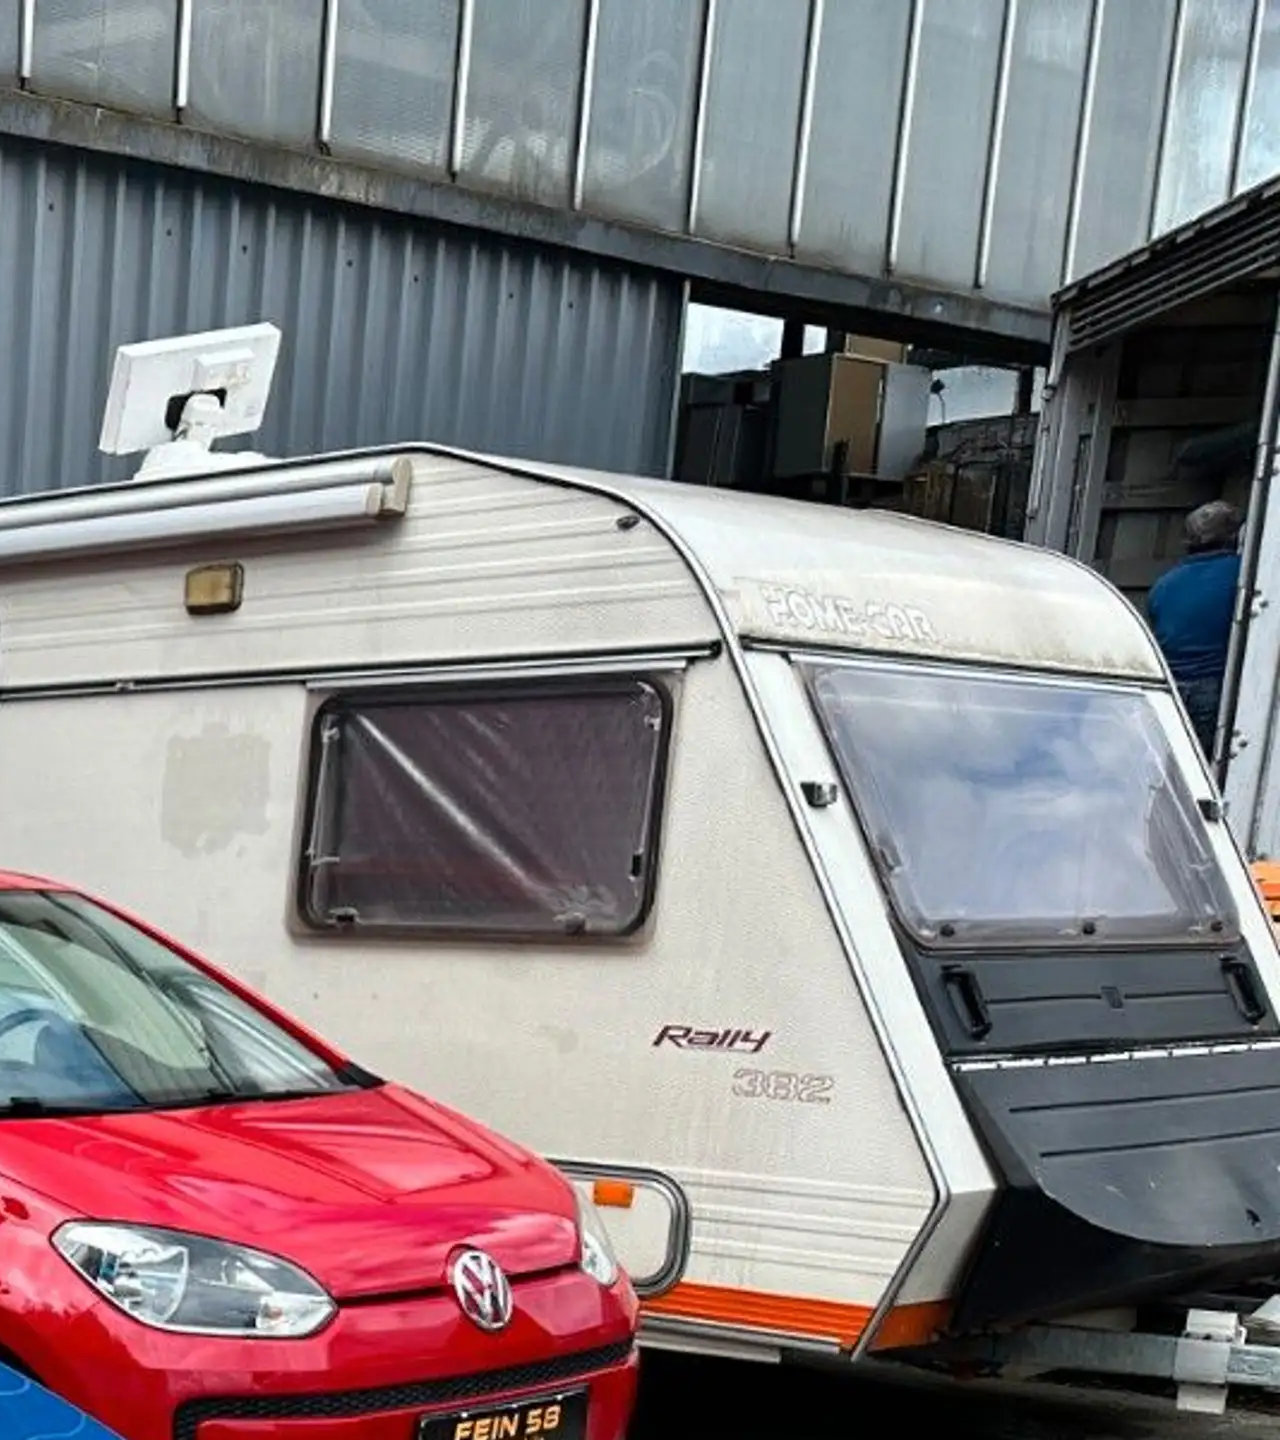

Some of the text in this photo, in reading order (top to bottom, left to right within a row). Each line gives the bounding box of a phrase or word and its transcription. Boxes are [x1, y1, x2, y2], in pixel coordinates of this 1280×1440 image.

[653, 1024, 772, 1053] Rally
[733, 1068, 834, 1105] 382
[524, 1404, 562, 1435] 58
